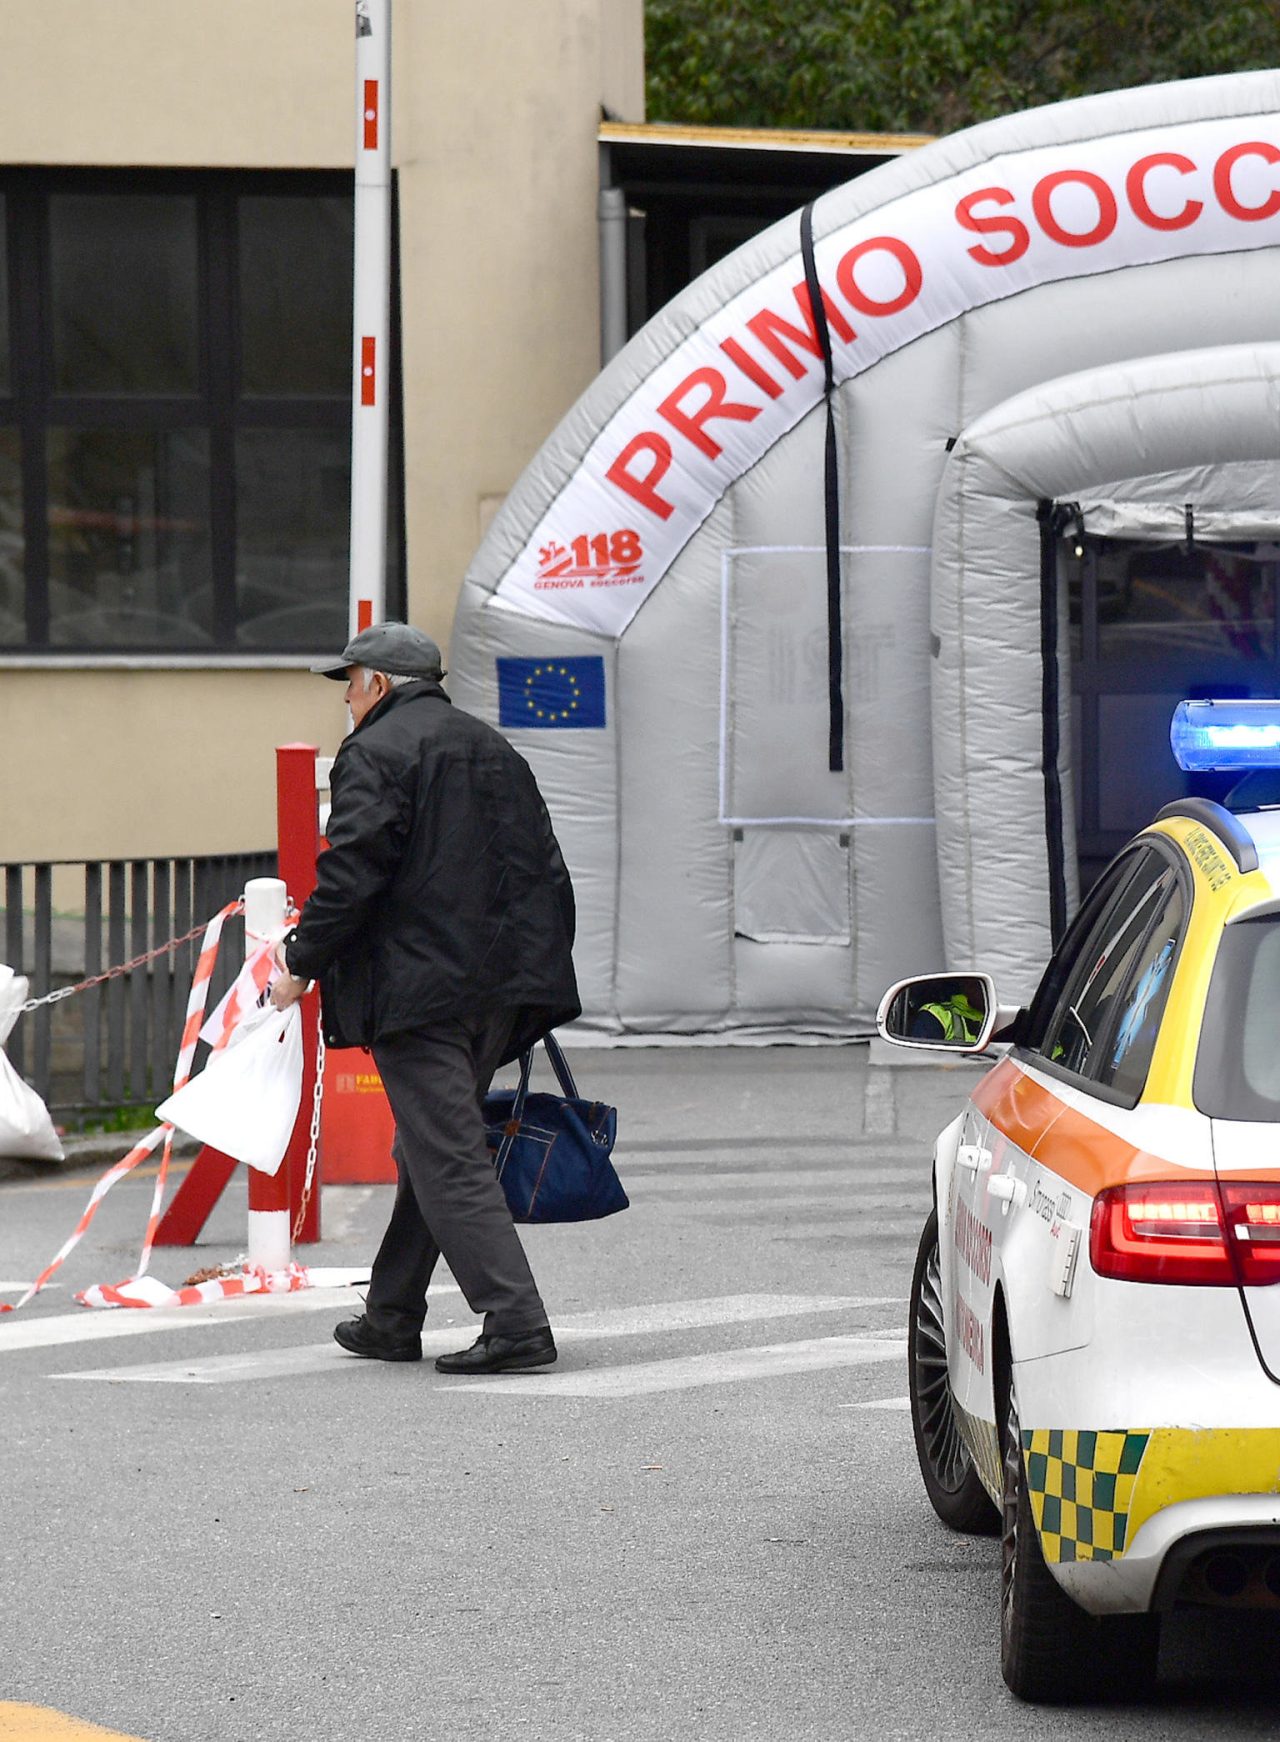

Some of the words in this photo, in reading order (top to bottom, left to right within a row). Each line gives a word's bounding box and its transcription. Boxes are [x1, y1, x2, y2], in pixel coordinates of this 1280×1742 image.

[605, 236, 924, 520] PRIMO
[571, 529, 643, 567] 118
[534, 579, 585, 591] GENOVA
